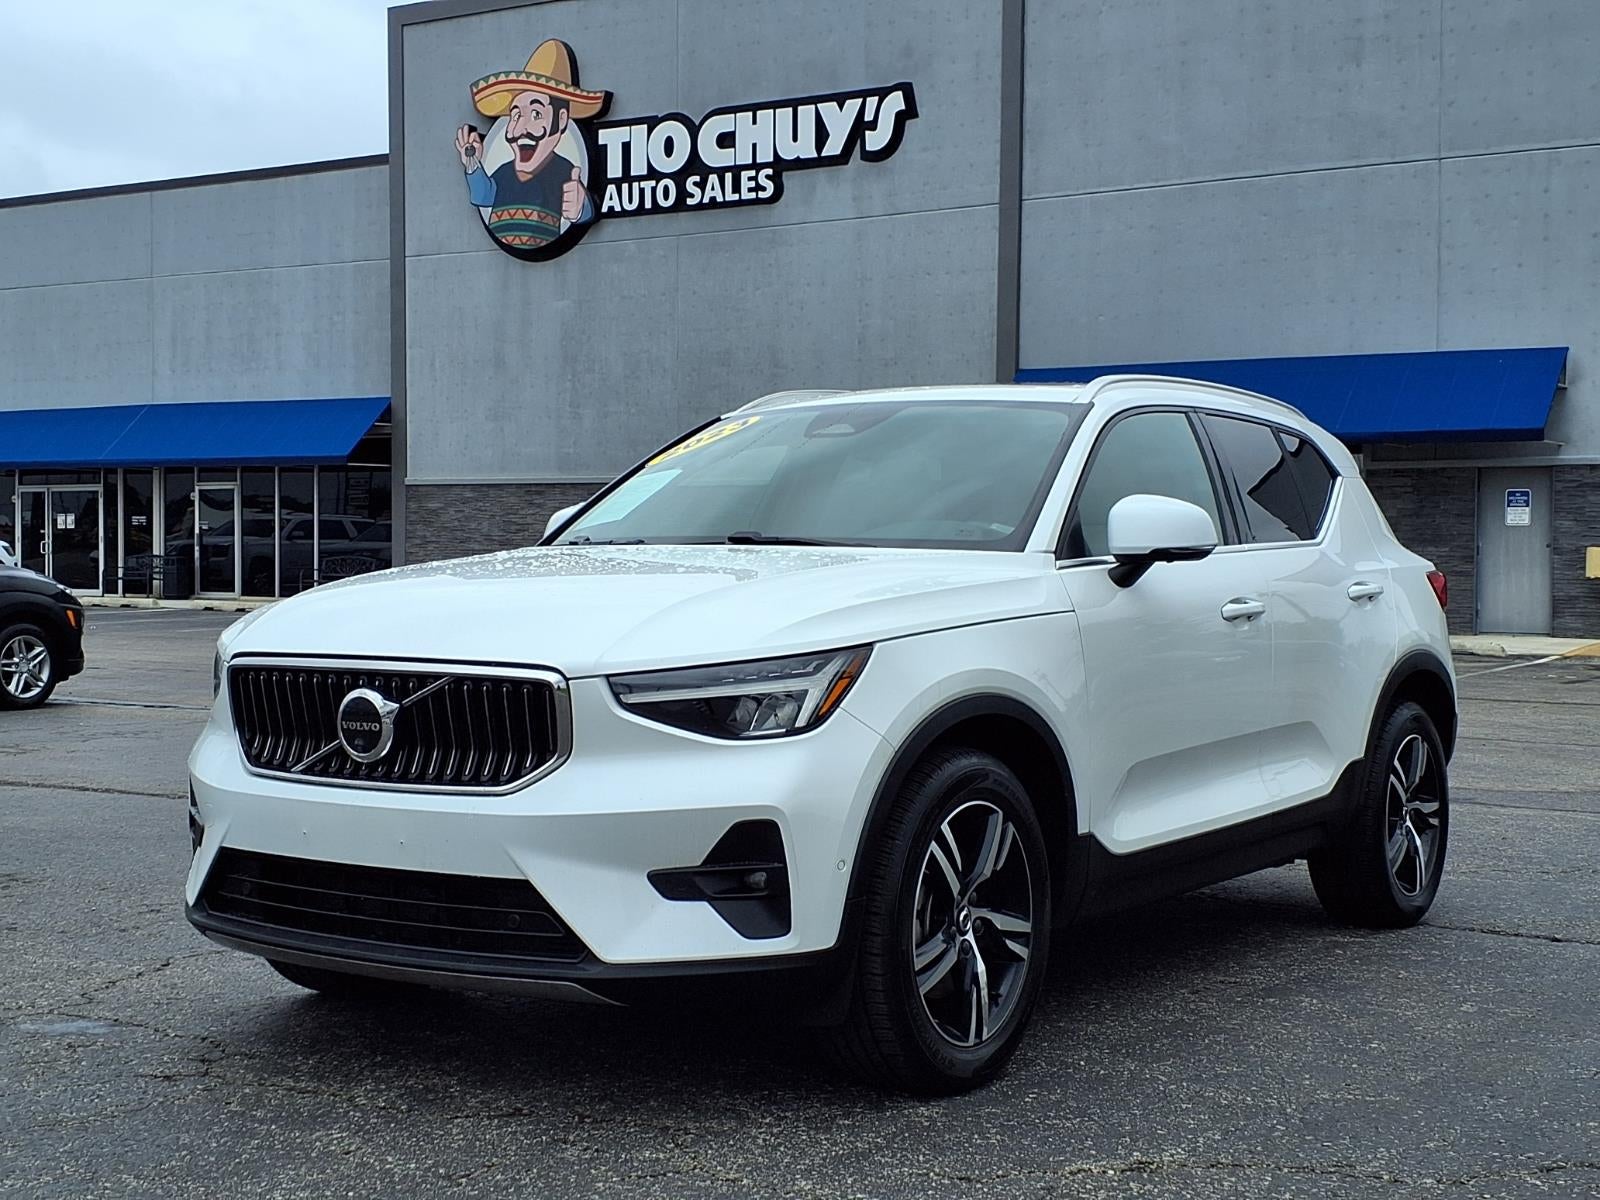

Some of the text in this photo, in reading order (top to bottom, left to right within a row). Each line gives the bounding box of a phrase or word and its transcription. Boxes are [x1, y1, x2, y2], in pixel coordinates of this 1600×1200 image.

[598, 90, 906, 179] TIO CHUY'S
[601, 168, 775, 213] AUTO SALES
[341, 721, 380, 732] VOLVO
